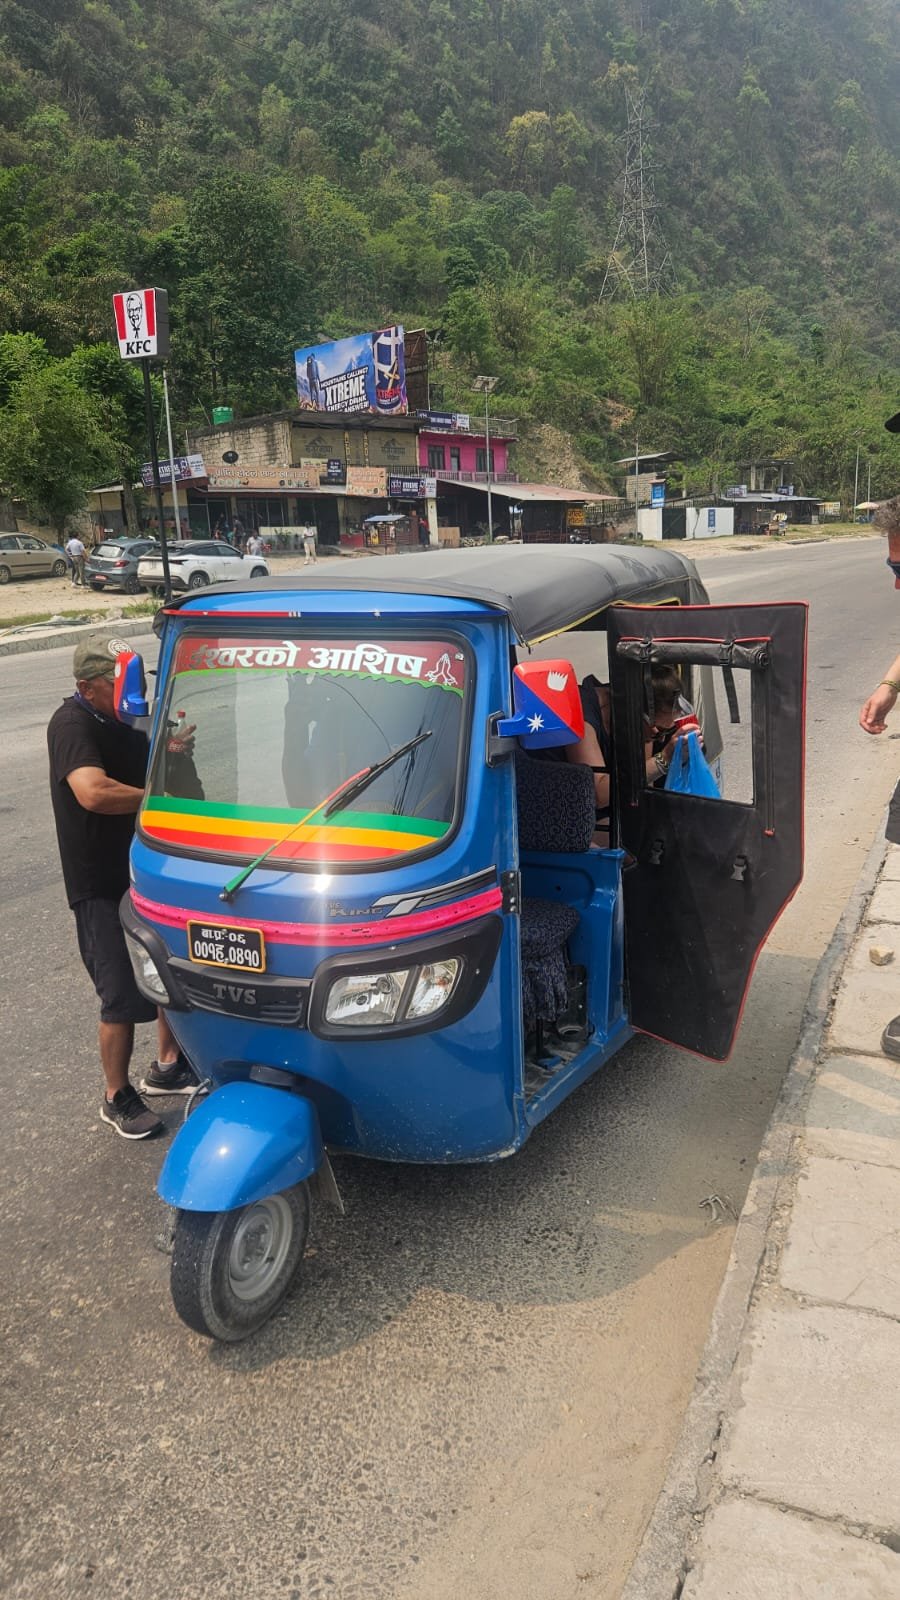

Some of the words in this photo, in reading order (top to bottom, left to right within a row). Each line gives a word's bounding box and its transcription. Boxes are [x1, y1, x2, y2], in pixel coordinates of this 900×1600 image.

[126, 340, 151, 355] KFC
[321, 374, 346, 388] MOUNTAINS
[326, 375, 365, 406] XTREME
[327, 400, 348, 412] ENERGY
[349, 394, 367, 405] DRINK
[189, 640, 300, 670] ईश्वरको
[308, 643, 427, 677] आशिष
[213, 983, 256, 1004] TVS
